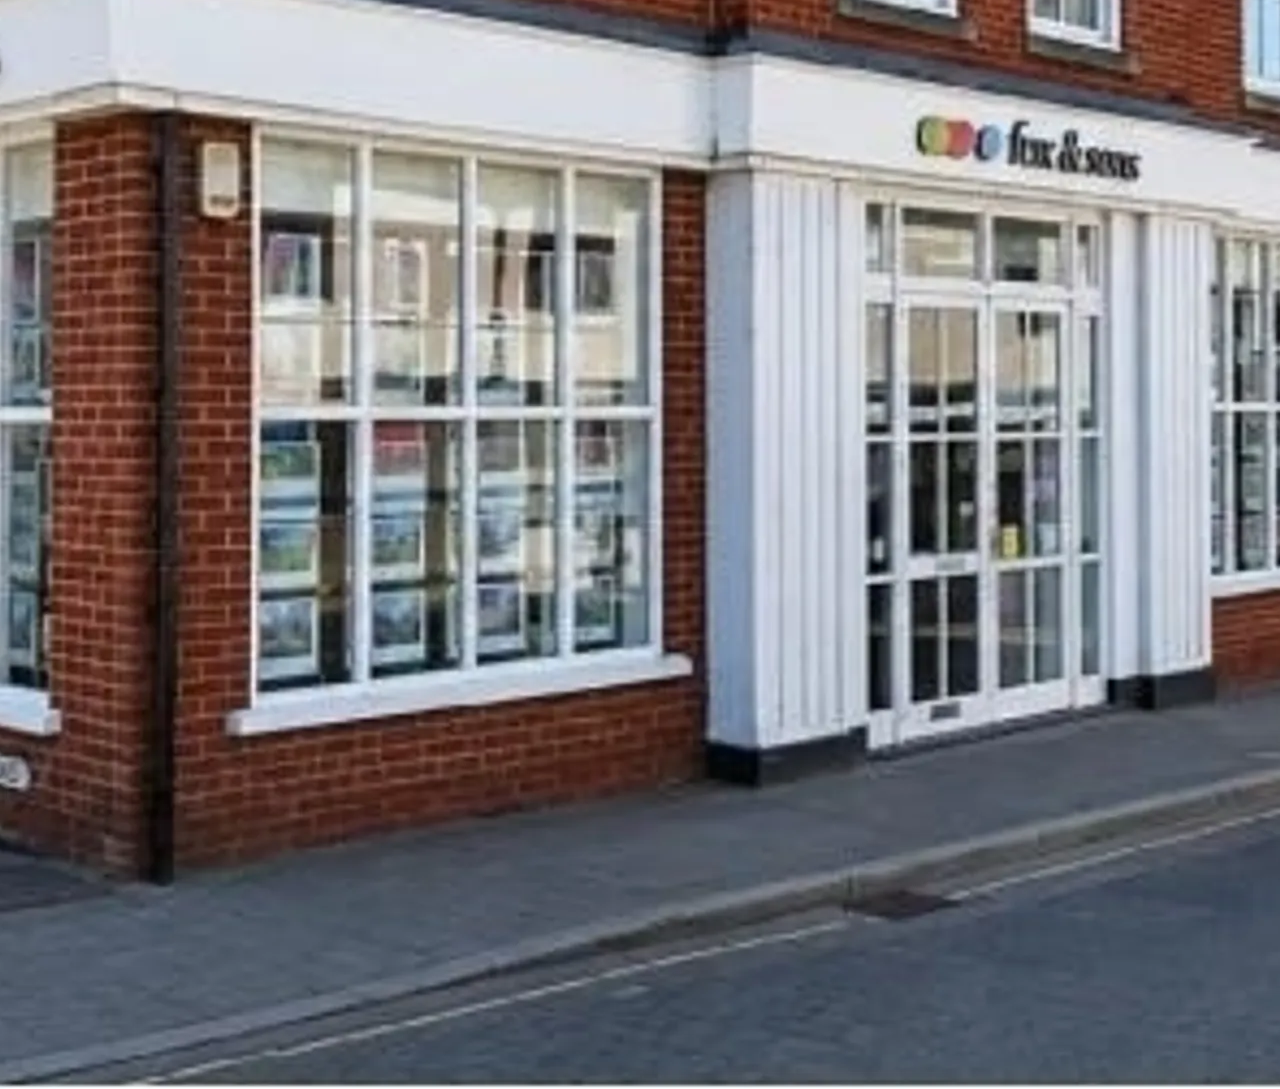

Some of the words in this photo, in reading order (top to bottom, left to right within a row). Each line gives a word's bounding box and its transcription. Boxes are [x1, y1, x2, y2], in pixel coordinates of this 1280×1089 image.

[1007, 120, 1056, 169] fox
[1058, 129, 1083, 174] &
[1084, 146, 1142, 182] sons
